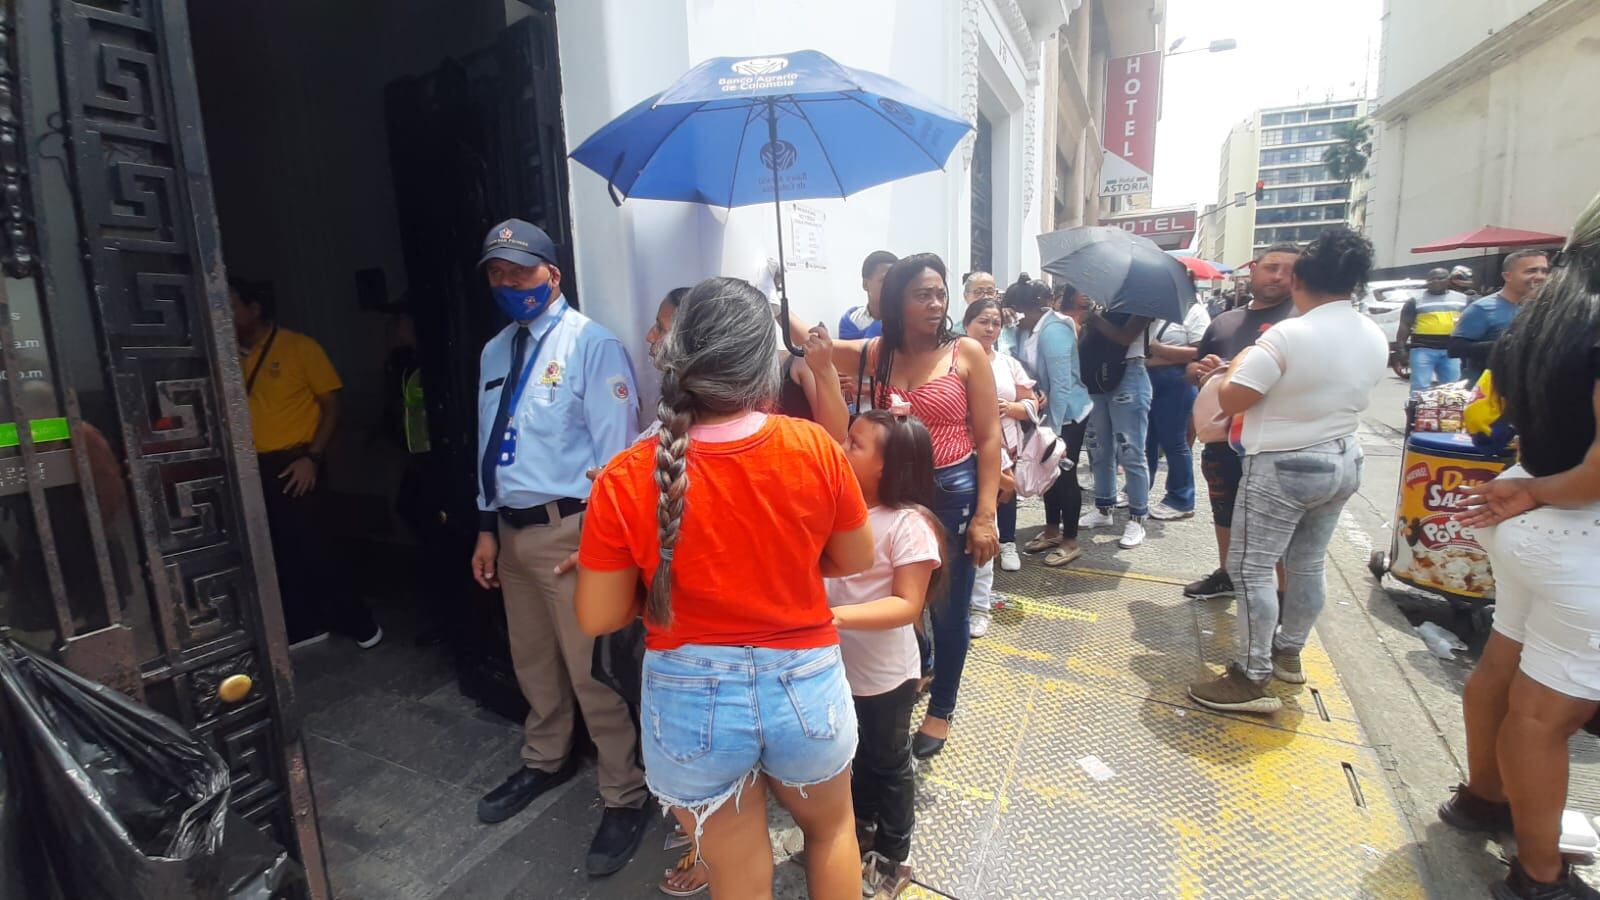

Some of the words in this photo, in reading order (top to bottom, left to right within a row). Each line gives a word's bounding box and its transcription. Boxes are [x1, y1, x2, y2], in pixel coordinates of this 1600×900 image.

[718, 76, 753, 86] Banco
[757, 72, 798, 82] Agrario
[740, 80, 794, 90] Colombia
[1123, 57, 1141, 157] HOTEL
[1103, 182, 1149, 193] ASTORIA
[1107, 217, 1184, 232] OTEL
